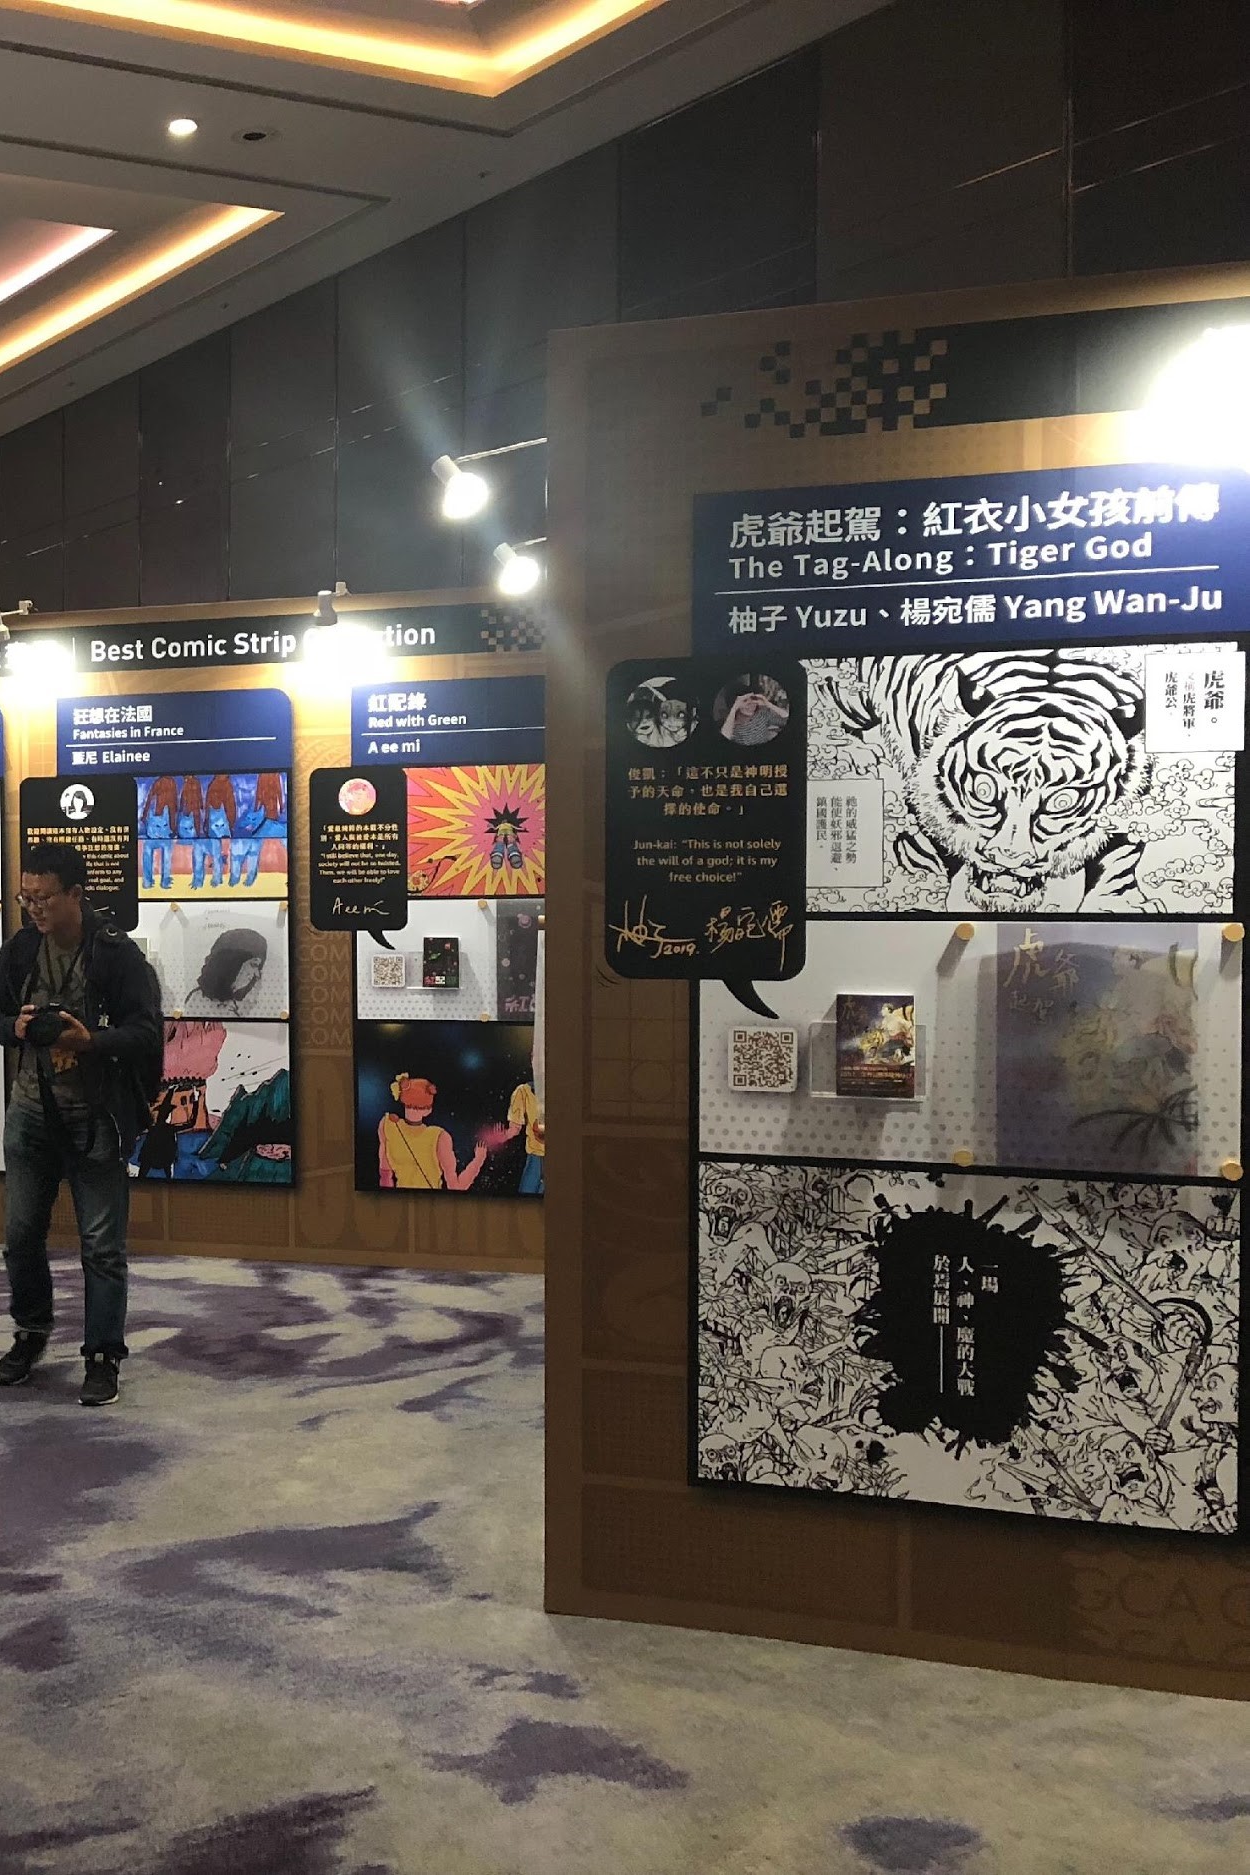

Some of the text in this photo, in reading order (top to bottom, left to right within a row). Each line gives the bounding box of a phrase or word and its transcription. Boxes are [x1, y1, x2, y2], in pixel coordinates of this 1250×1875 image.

[728, 556, 784, 580] The
[987, 540, 1076, 571] Tiger
[1085, 532, 1152, 560] God
[728, 605, 788, 634] 柚子
[1004, 594, 1087, 624] Yang
[1093, 586, 1222, 615] Wan-Ju
[91, 640, 144, 662] Best
[151, 634, 227, 659] Comic
[234, 630, 296, 658] Strip
[368, 714, 467, 728] Red with Green
[73, 726, 184, 740] Fantasies in France
[367, 739, 420, 754] A ee mi
[102, 750, 151, 763] Elainee
[633, 839, 677, 850] Jun-kai:
[713, 839, 722, 849] is
[725, 840, 744, 849] not
[747, 838, 781, 851] solely
[637, 856, 655, 866] the
[658, 855, 679, 866] will
[681, 855, 693, 866] of
[696, 858, 704, 866] a
[736, 855, 745, 866] it
[748, 855, 757, 866] is
[760, 857, 778, 867] my
[669, 872, 691, 882] free
